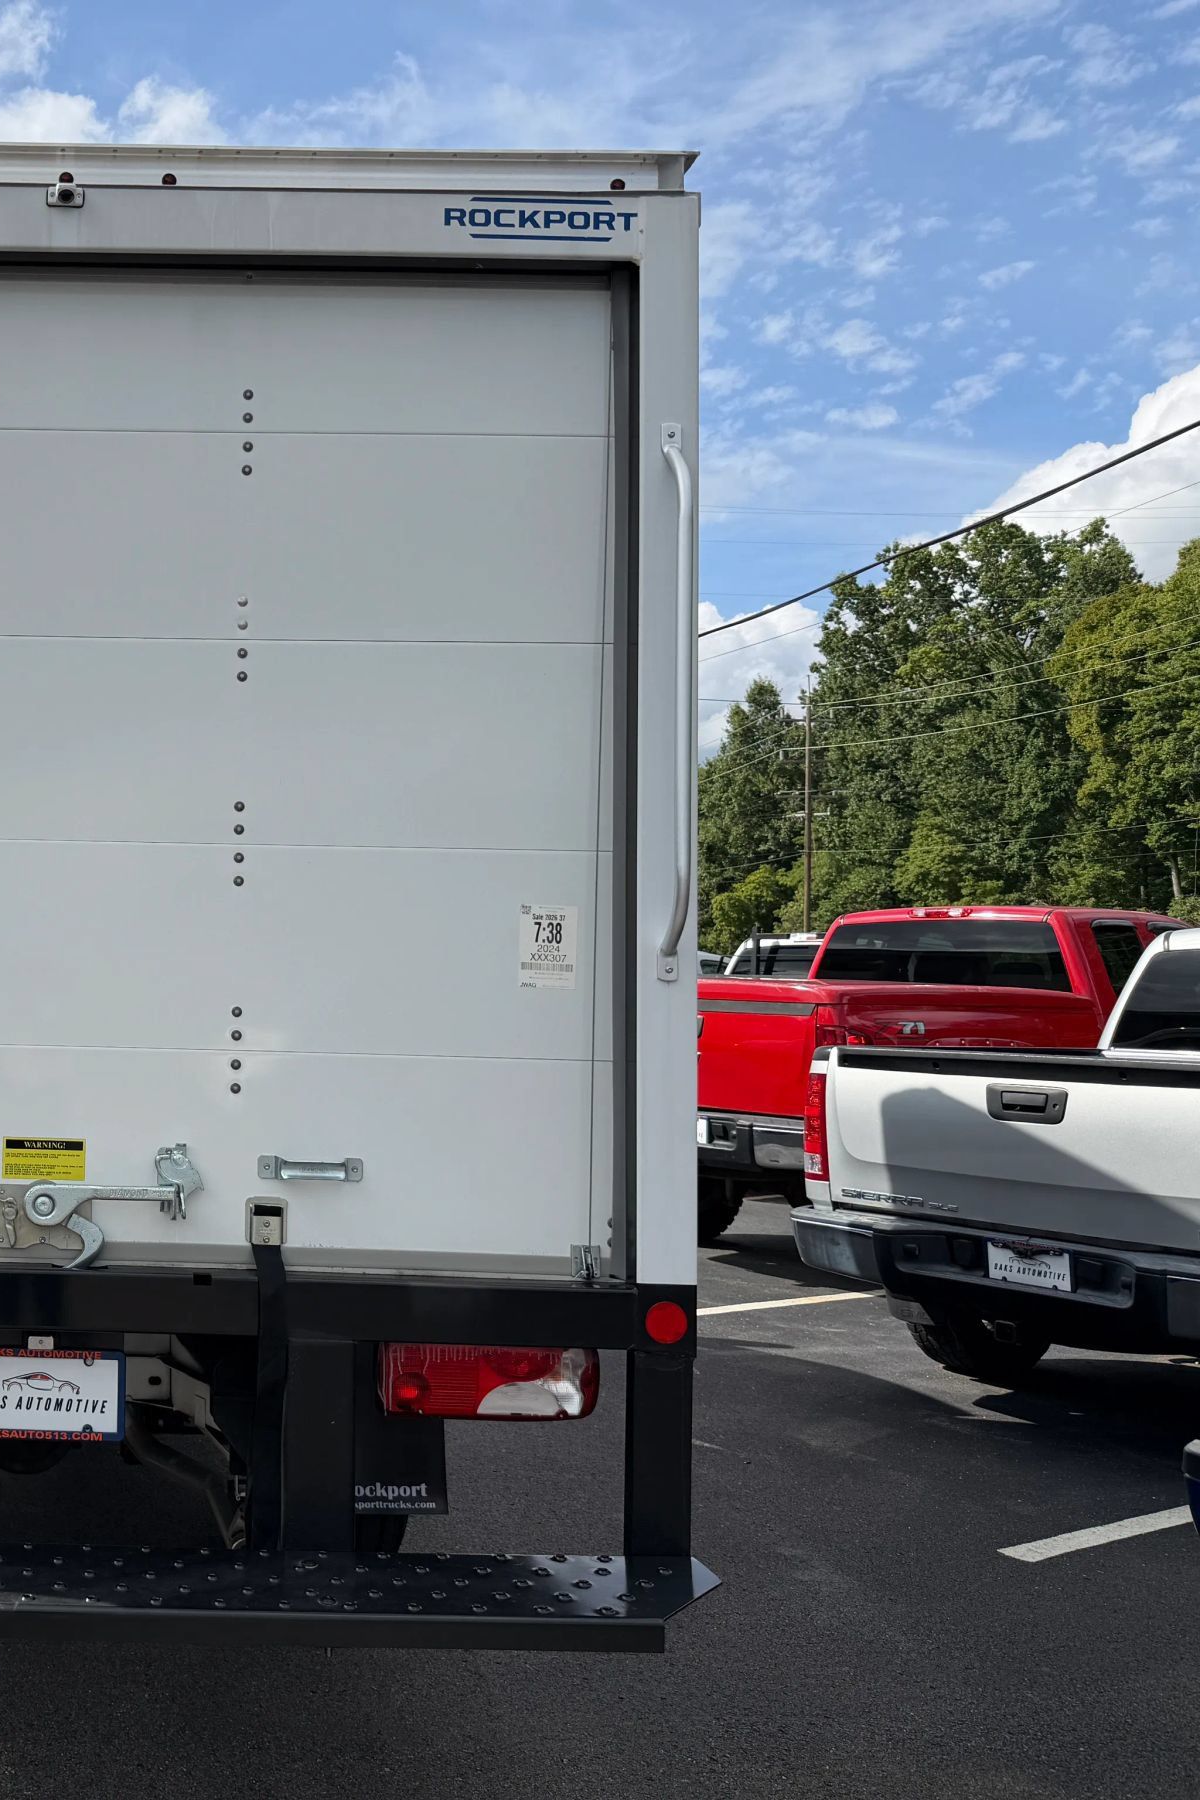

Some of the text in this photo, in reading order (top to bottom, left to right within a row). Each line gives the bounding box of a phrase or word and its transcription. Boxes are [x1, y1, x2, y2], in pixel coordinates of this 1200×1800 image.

[444, 207, 638, 232] ROCKPORT
[534, 921, 562, 944] 7:38
[537, 944, 560, 953] 2024
[530, 953, 567, 963] XXX307
[24, 1141, 66, 1150] WARNING!
[841, 1188, 924, 1207] SIERRA
[994, 1262, 1067, 1282] OAKS AUTOMOTIVE
[18, 1349, 102, 1360] AUTOMOTIVE
[15, 1396, 107, 1414] AUTOMOTIVE
